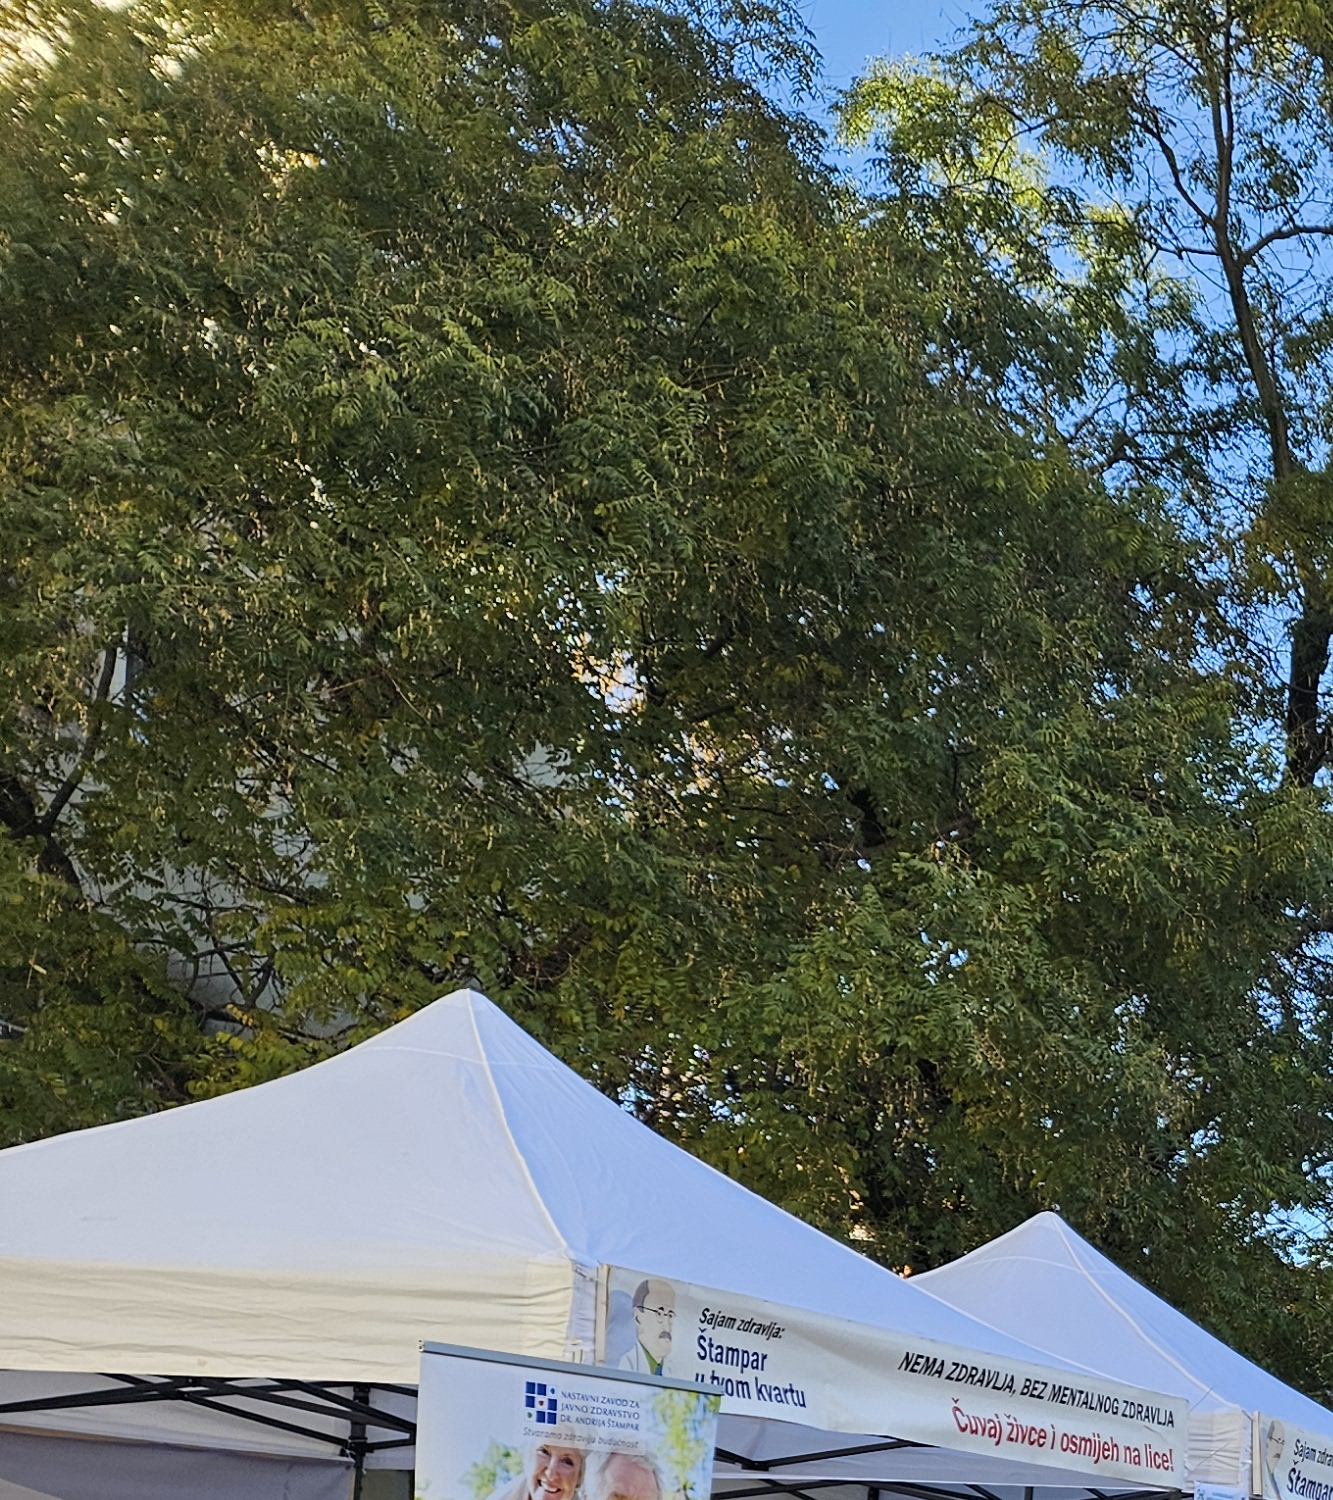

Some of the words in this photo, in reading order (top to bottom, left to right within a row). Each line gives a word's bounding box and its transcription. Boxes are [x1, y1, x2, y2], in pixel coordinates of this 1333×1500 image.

[699, 1307, 736, 1330] Sajam
[738, 1316, 786, 1341] zdravlja:
[696, 1327, 768, 1374] Štampar
[561, 1391, 599, 1404] NASTAVNI
[600, 1396, 629, 1408] ZAVOD
[628, 1400, 640, 1409] ZA
[754, 1376, 806, 1408] kvartu
[897, 1351, 943, 1378] NEMA
[945, 1362, 1017, 1398] ZDRAVLJA,
[1020, 1378, 1045, 1400] BEZ
[1047, 1384, 1120, 1416] MENTALNOG
[1121, 1400, 1174, 1428] ZDRAVLJA
[560, 1402, 588, 1414] JAVNO
[590, 1406, 640, 1420] ZDRAVSTVO
[952, 1397, 1002, 1446] Čuvaj
[1006, 1413, 1046, 1448] živce
[1050, 1424, 1056, 1450] i
[1060, 1432, 1120, 1464] osmijeh
[1124, 1444, 1141, 1466] na
[1144, 1444, 1174, 1472] lice!
[1294, 1438, 1316, 1462] Sajam
